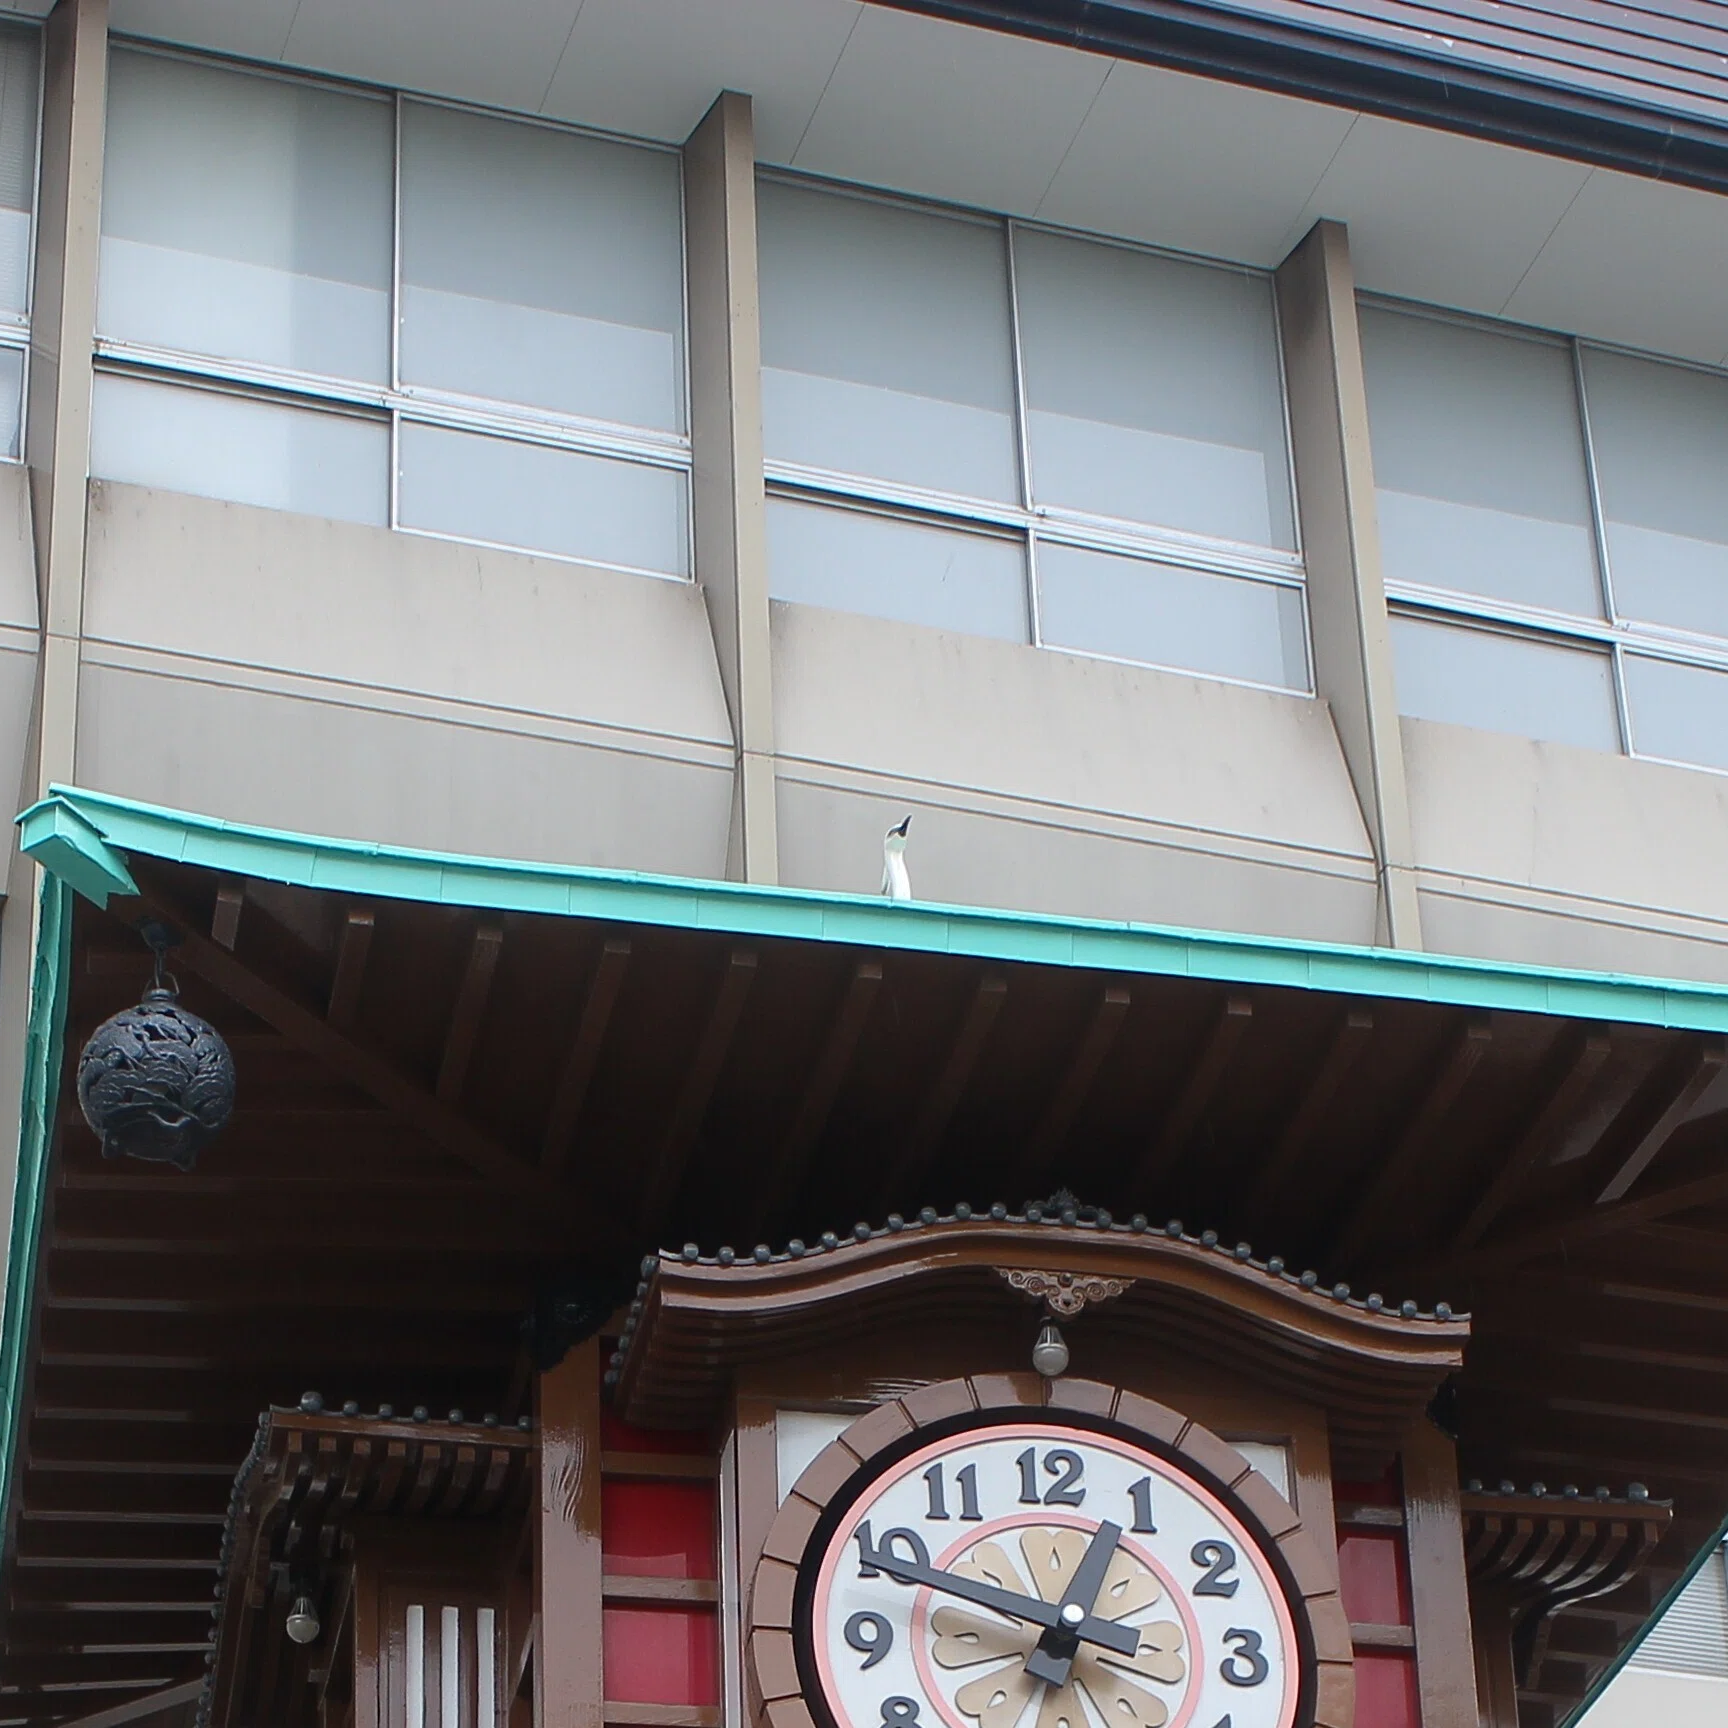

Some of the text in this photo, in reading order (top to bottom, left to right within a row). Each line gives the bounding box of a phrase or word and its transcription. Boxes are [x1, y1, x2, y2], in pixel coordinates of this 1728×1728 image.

[922, 1462, 983, 1522] 11
[1016, 1447, 1087, 1508] 12
[1127, 1476, 1158, 1535] 1
[854, 1520, 930, 1585] 10
[1190, 1539, 1240, 1599] 2
[843, 1611, 894, 1671] 9
[1219, 1627, 1269, 1688] 3
